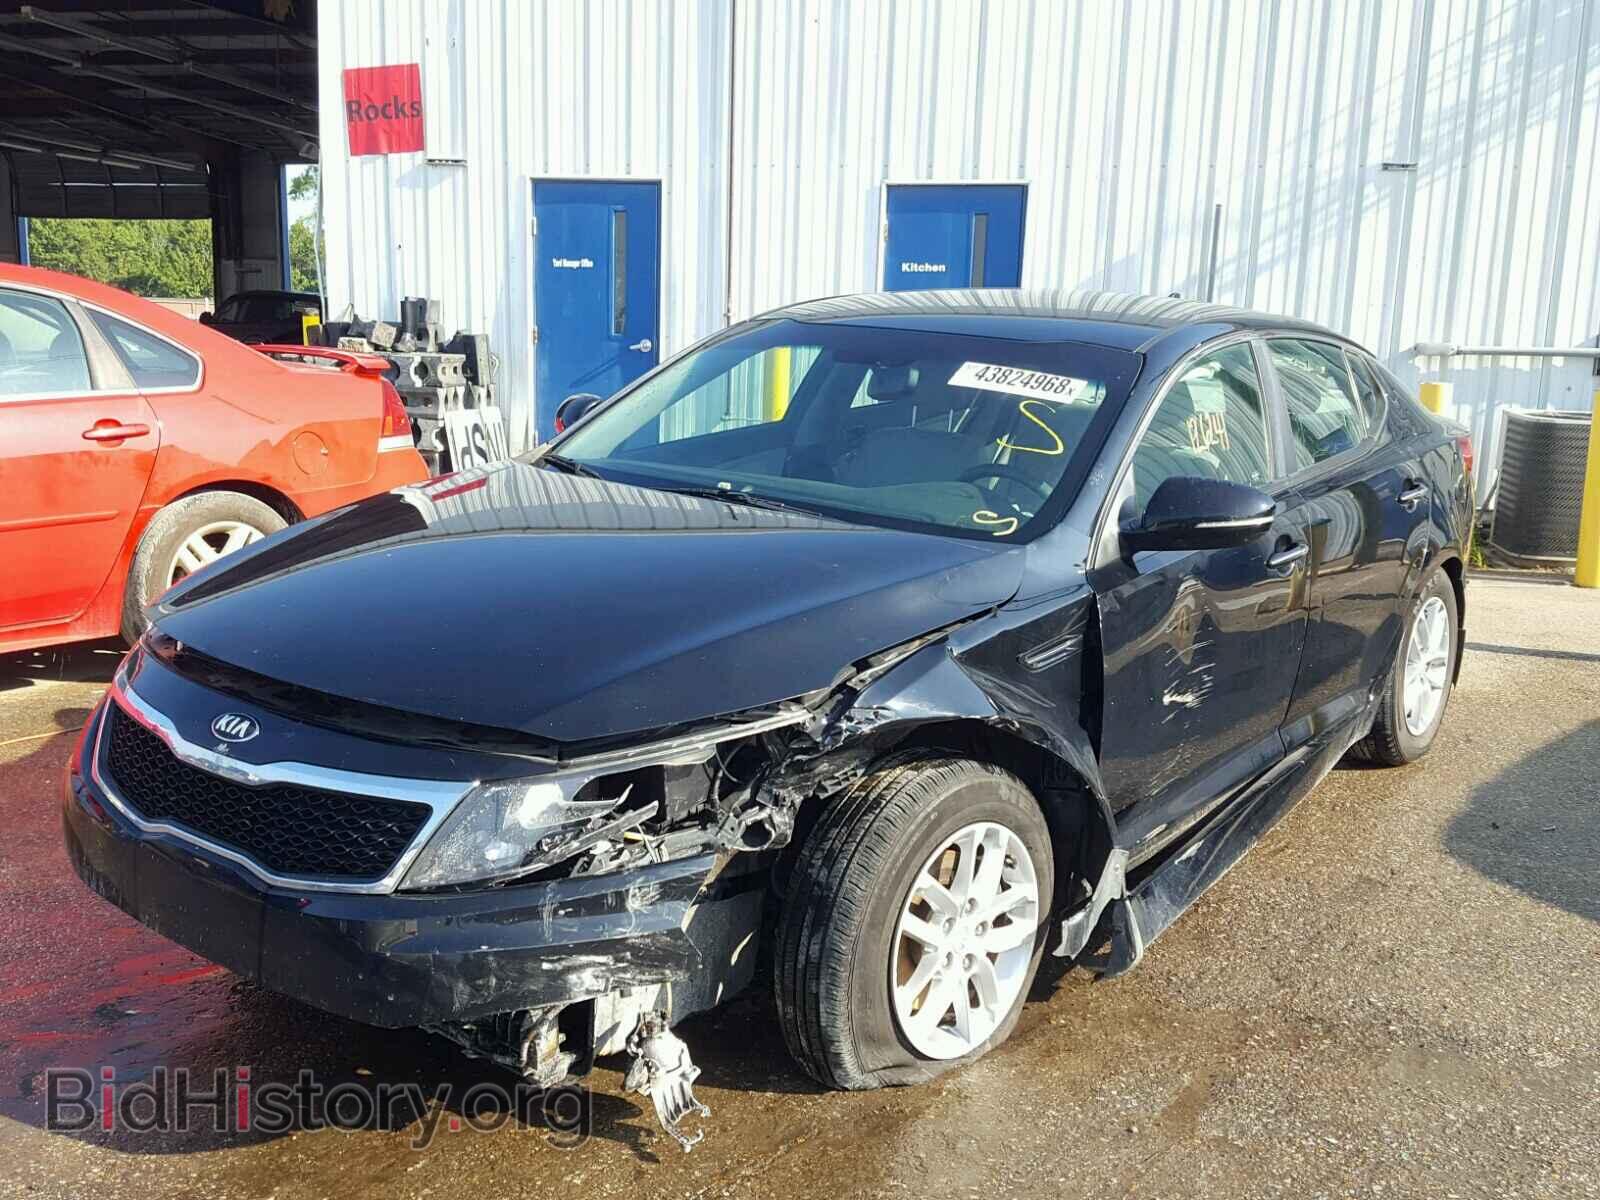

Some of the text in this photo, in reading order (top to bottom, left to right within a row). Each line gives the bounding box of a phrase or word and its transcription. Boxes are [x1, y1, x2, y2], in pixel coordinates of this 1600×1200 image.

[346, 95, 421, 122] Rocks
[901, 261, 946, 273] Kitchen
[215, 714, 251, 738] KIA
